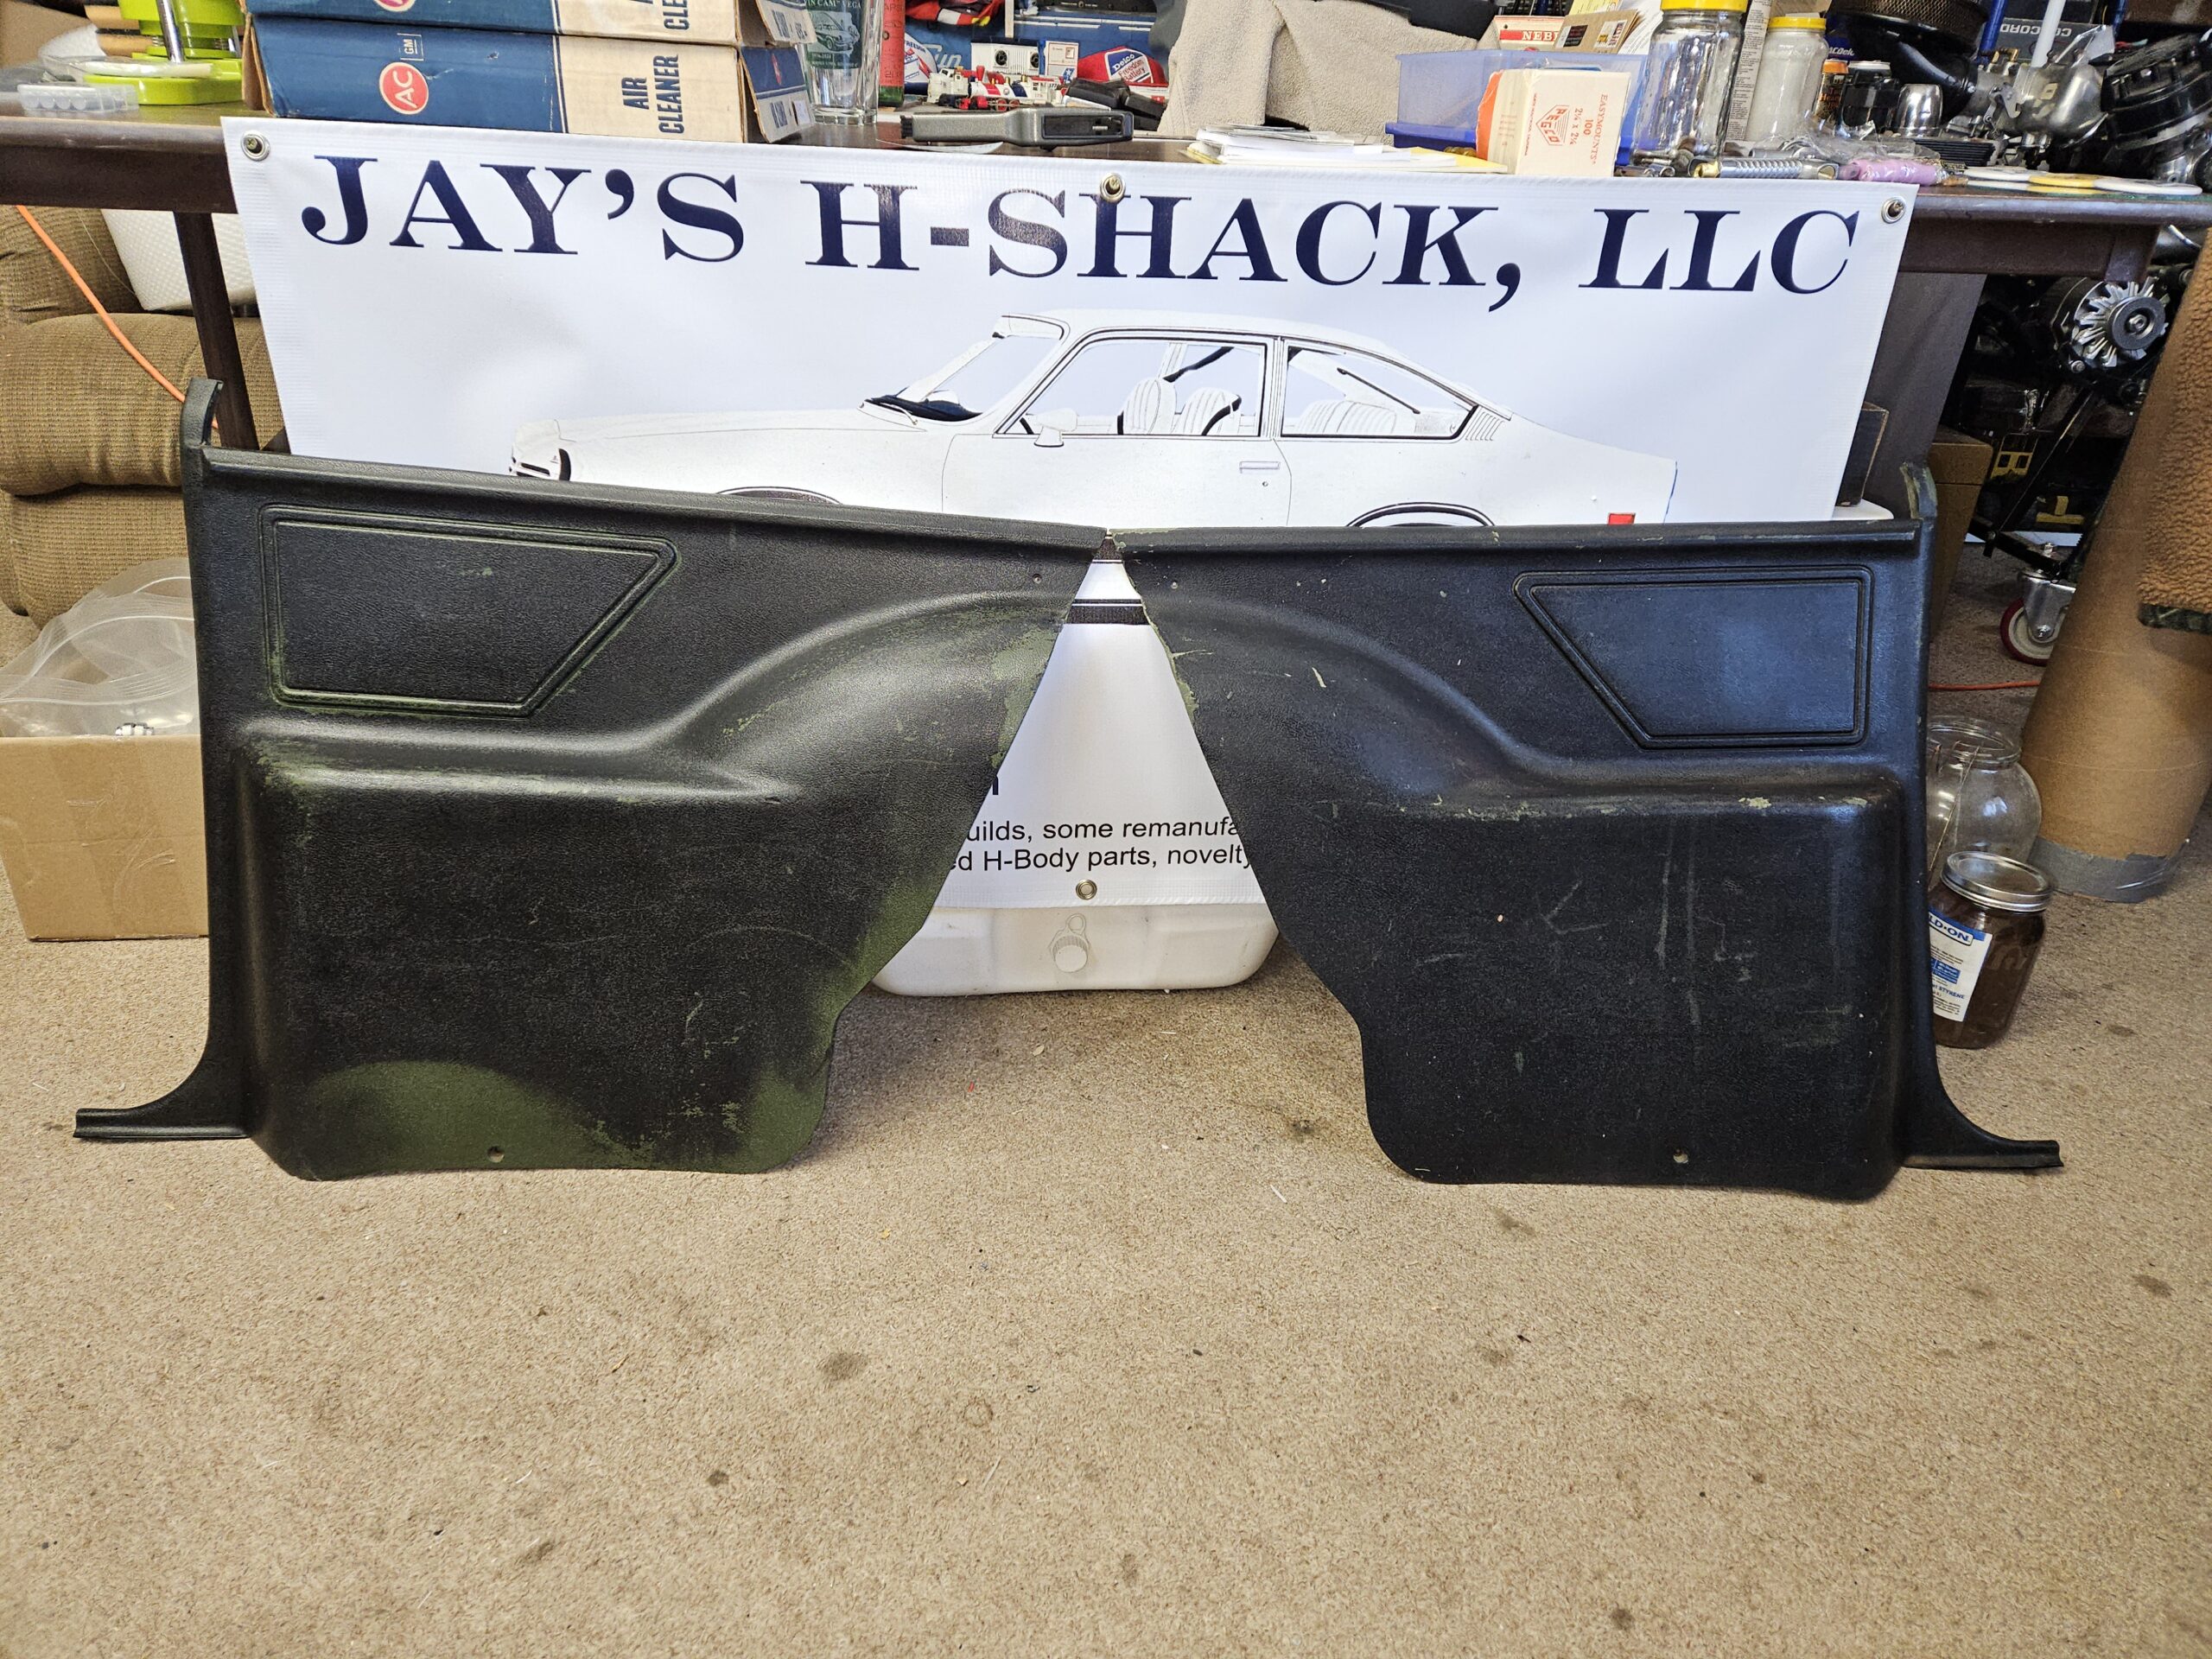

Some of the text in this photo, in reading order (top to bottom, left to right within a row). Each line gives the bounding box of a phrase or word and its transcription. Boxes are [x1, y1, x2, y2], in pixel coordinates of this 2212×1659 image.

[2000, 23, 2072, 37] CCORD
[403, 39, 415, 54] GM
[1112, 54, 1135, 71] Delco
[392, 70, 417, 109] AC
[621, 76, 650, 111] AIR
[652, 54, 685, 134] CLEANER
[1583, 119, 1593, 136] 100
[302, 155, 1860, 313] JAY'S H-SHACK, LLC
[1043, 823, 1114, 839] some
[983, 848, 1079, 873] H-Body
[1088, 846, 1157, 872] parts,
